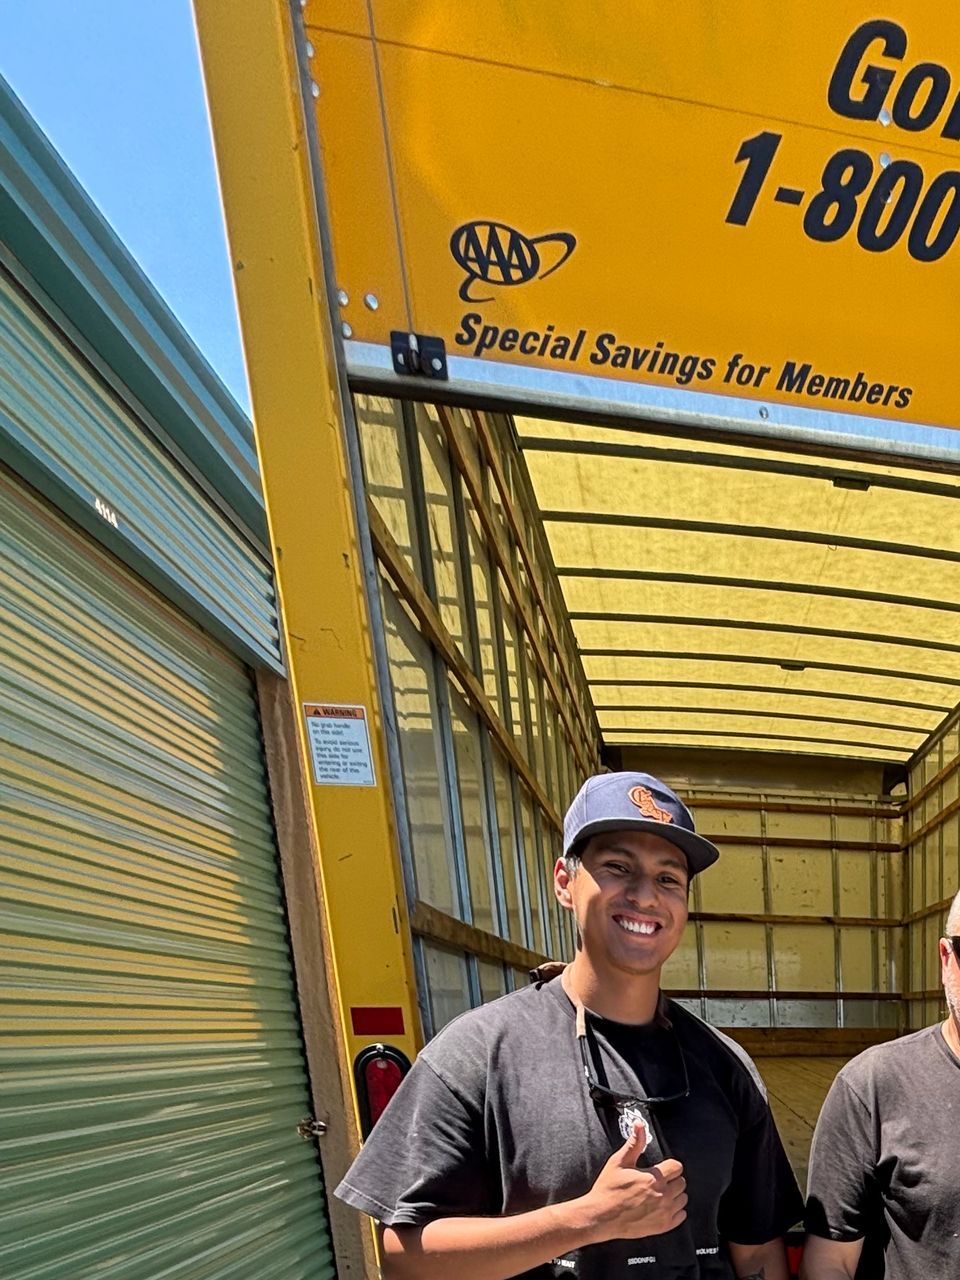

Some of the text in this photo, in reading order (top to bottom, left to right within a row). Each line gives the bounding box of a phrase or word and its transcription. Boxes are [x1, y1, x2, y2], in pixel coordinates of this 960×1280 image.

[454, 312, 913, 409] Special Savings for Members
[323, 708, 357, 717] WARNING
